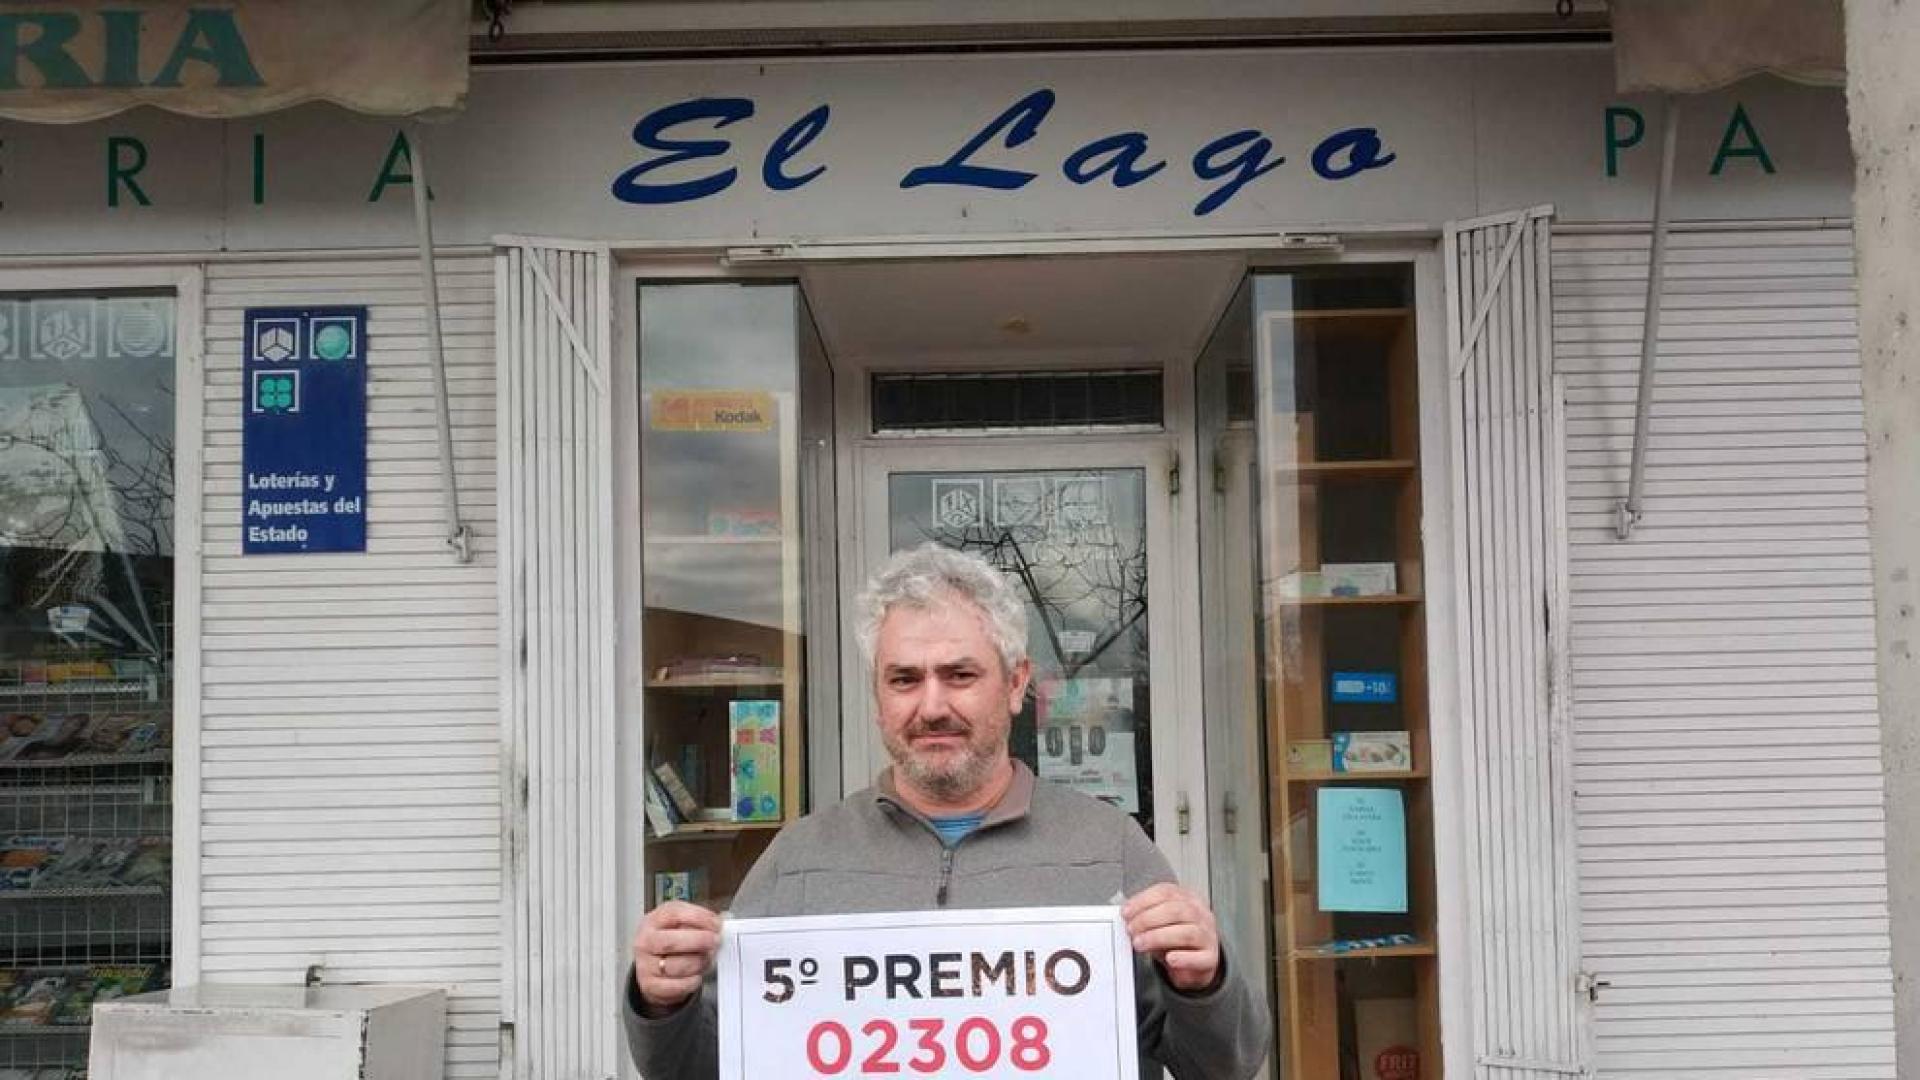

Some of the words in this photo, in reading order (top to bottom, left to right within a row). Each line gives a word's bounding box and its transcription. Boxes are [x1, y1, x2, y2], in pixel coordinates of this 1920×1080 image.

[612, 97, 829, 204] El
[900, 88, 1396, 216] Lago
[1605, 102, 1776, 178] PA
[0, 129, 434, 208] RIA
[714, 408, 762, 424] Kodak
[249, 472, 319, 490] Loterías
[324, 474, 336, 491] y
[249, 499, 328, 518] Apuestas
[334, 497, 361, 515] del
[249, 525, 309, 543] Estado
[844, 949, 1091, 1001] PREMIO
[806, 1015, 1051, 1076] 02308
